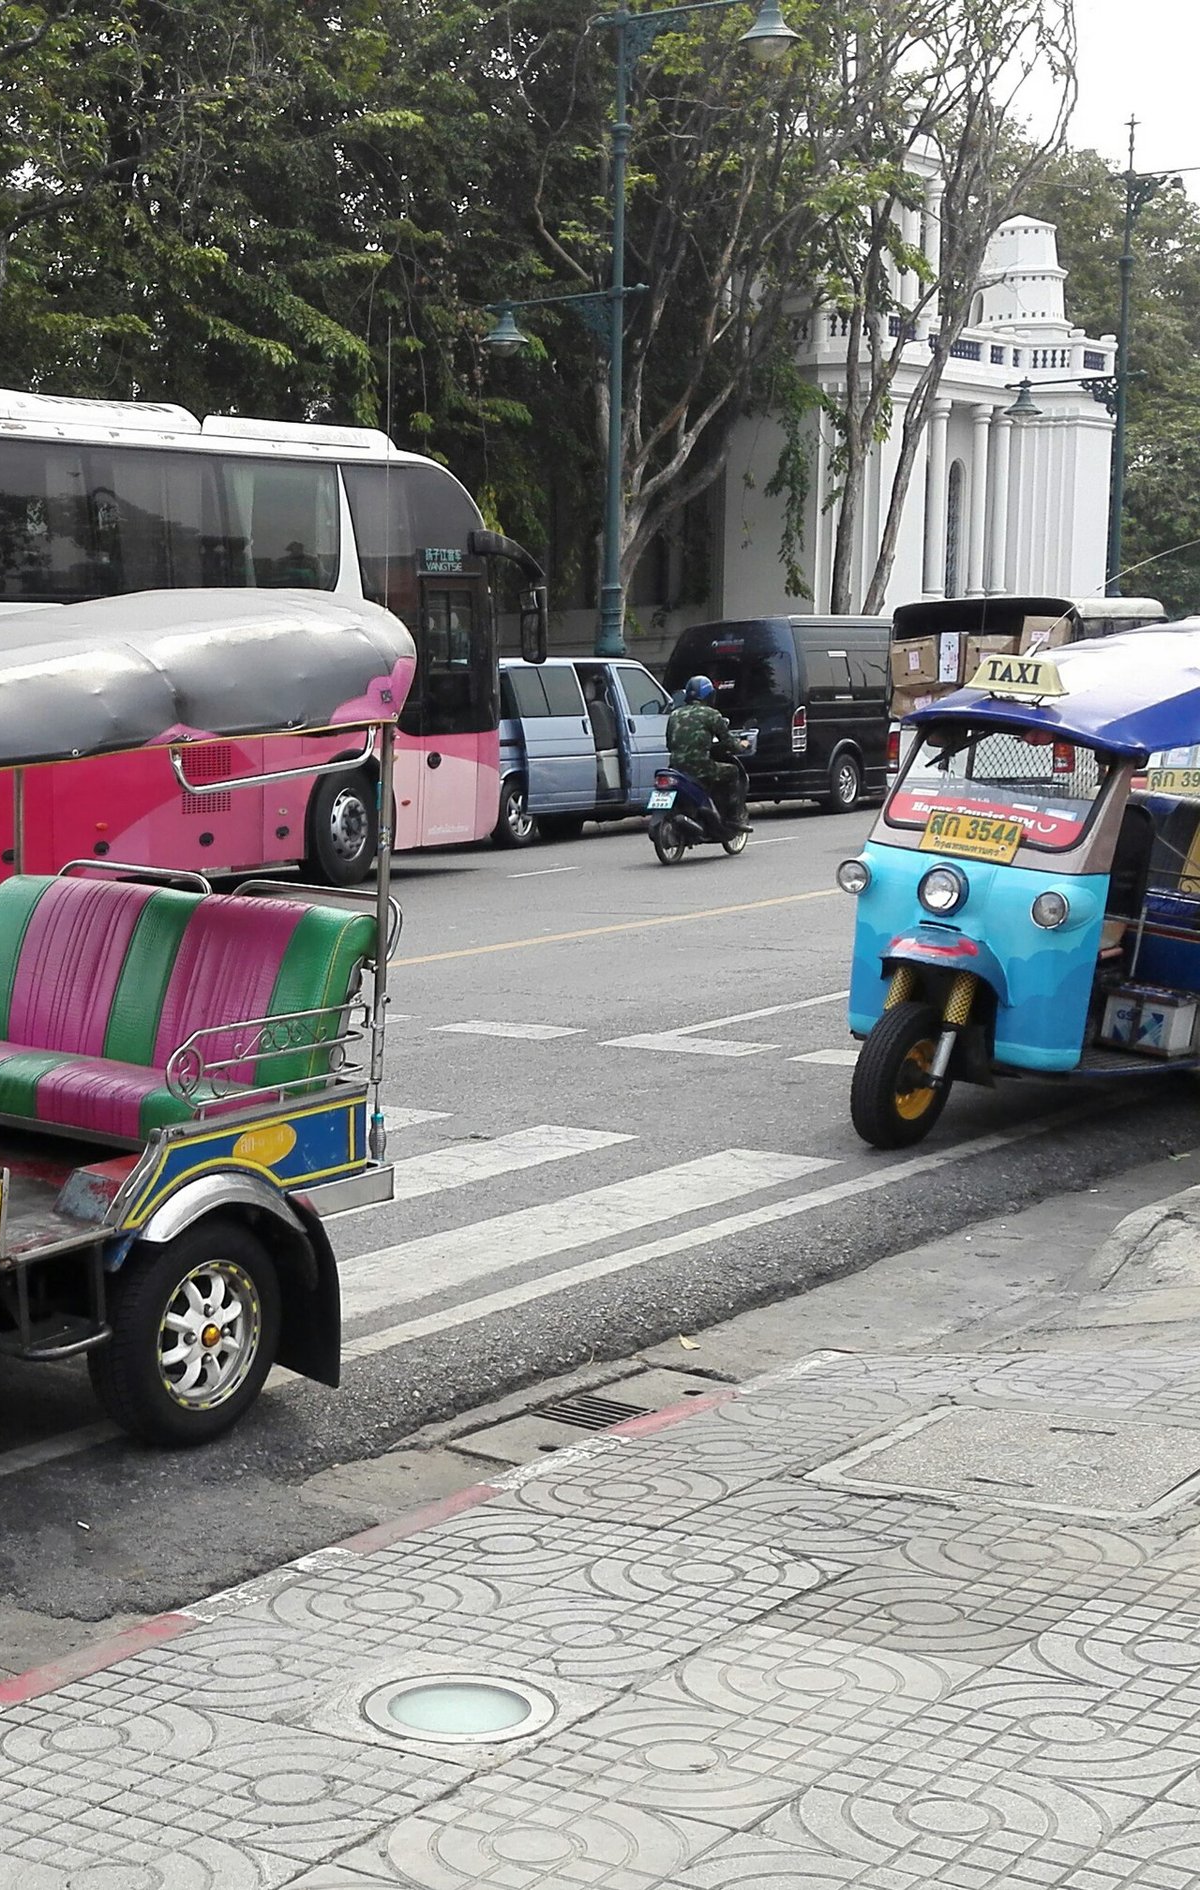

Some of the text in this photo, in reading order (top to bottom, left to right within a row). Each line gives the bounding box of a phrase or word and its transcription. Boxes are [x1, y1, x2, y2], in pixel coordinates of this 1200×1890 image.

[425, 561, 463, 572] YANGTSE
[987, 660, 1042, 685] TAXI
[966, 818, 1019, 846] 3544
